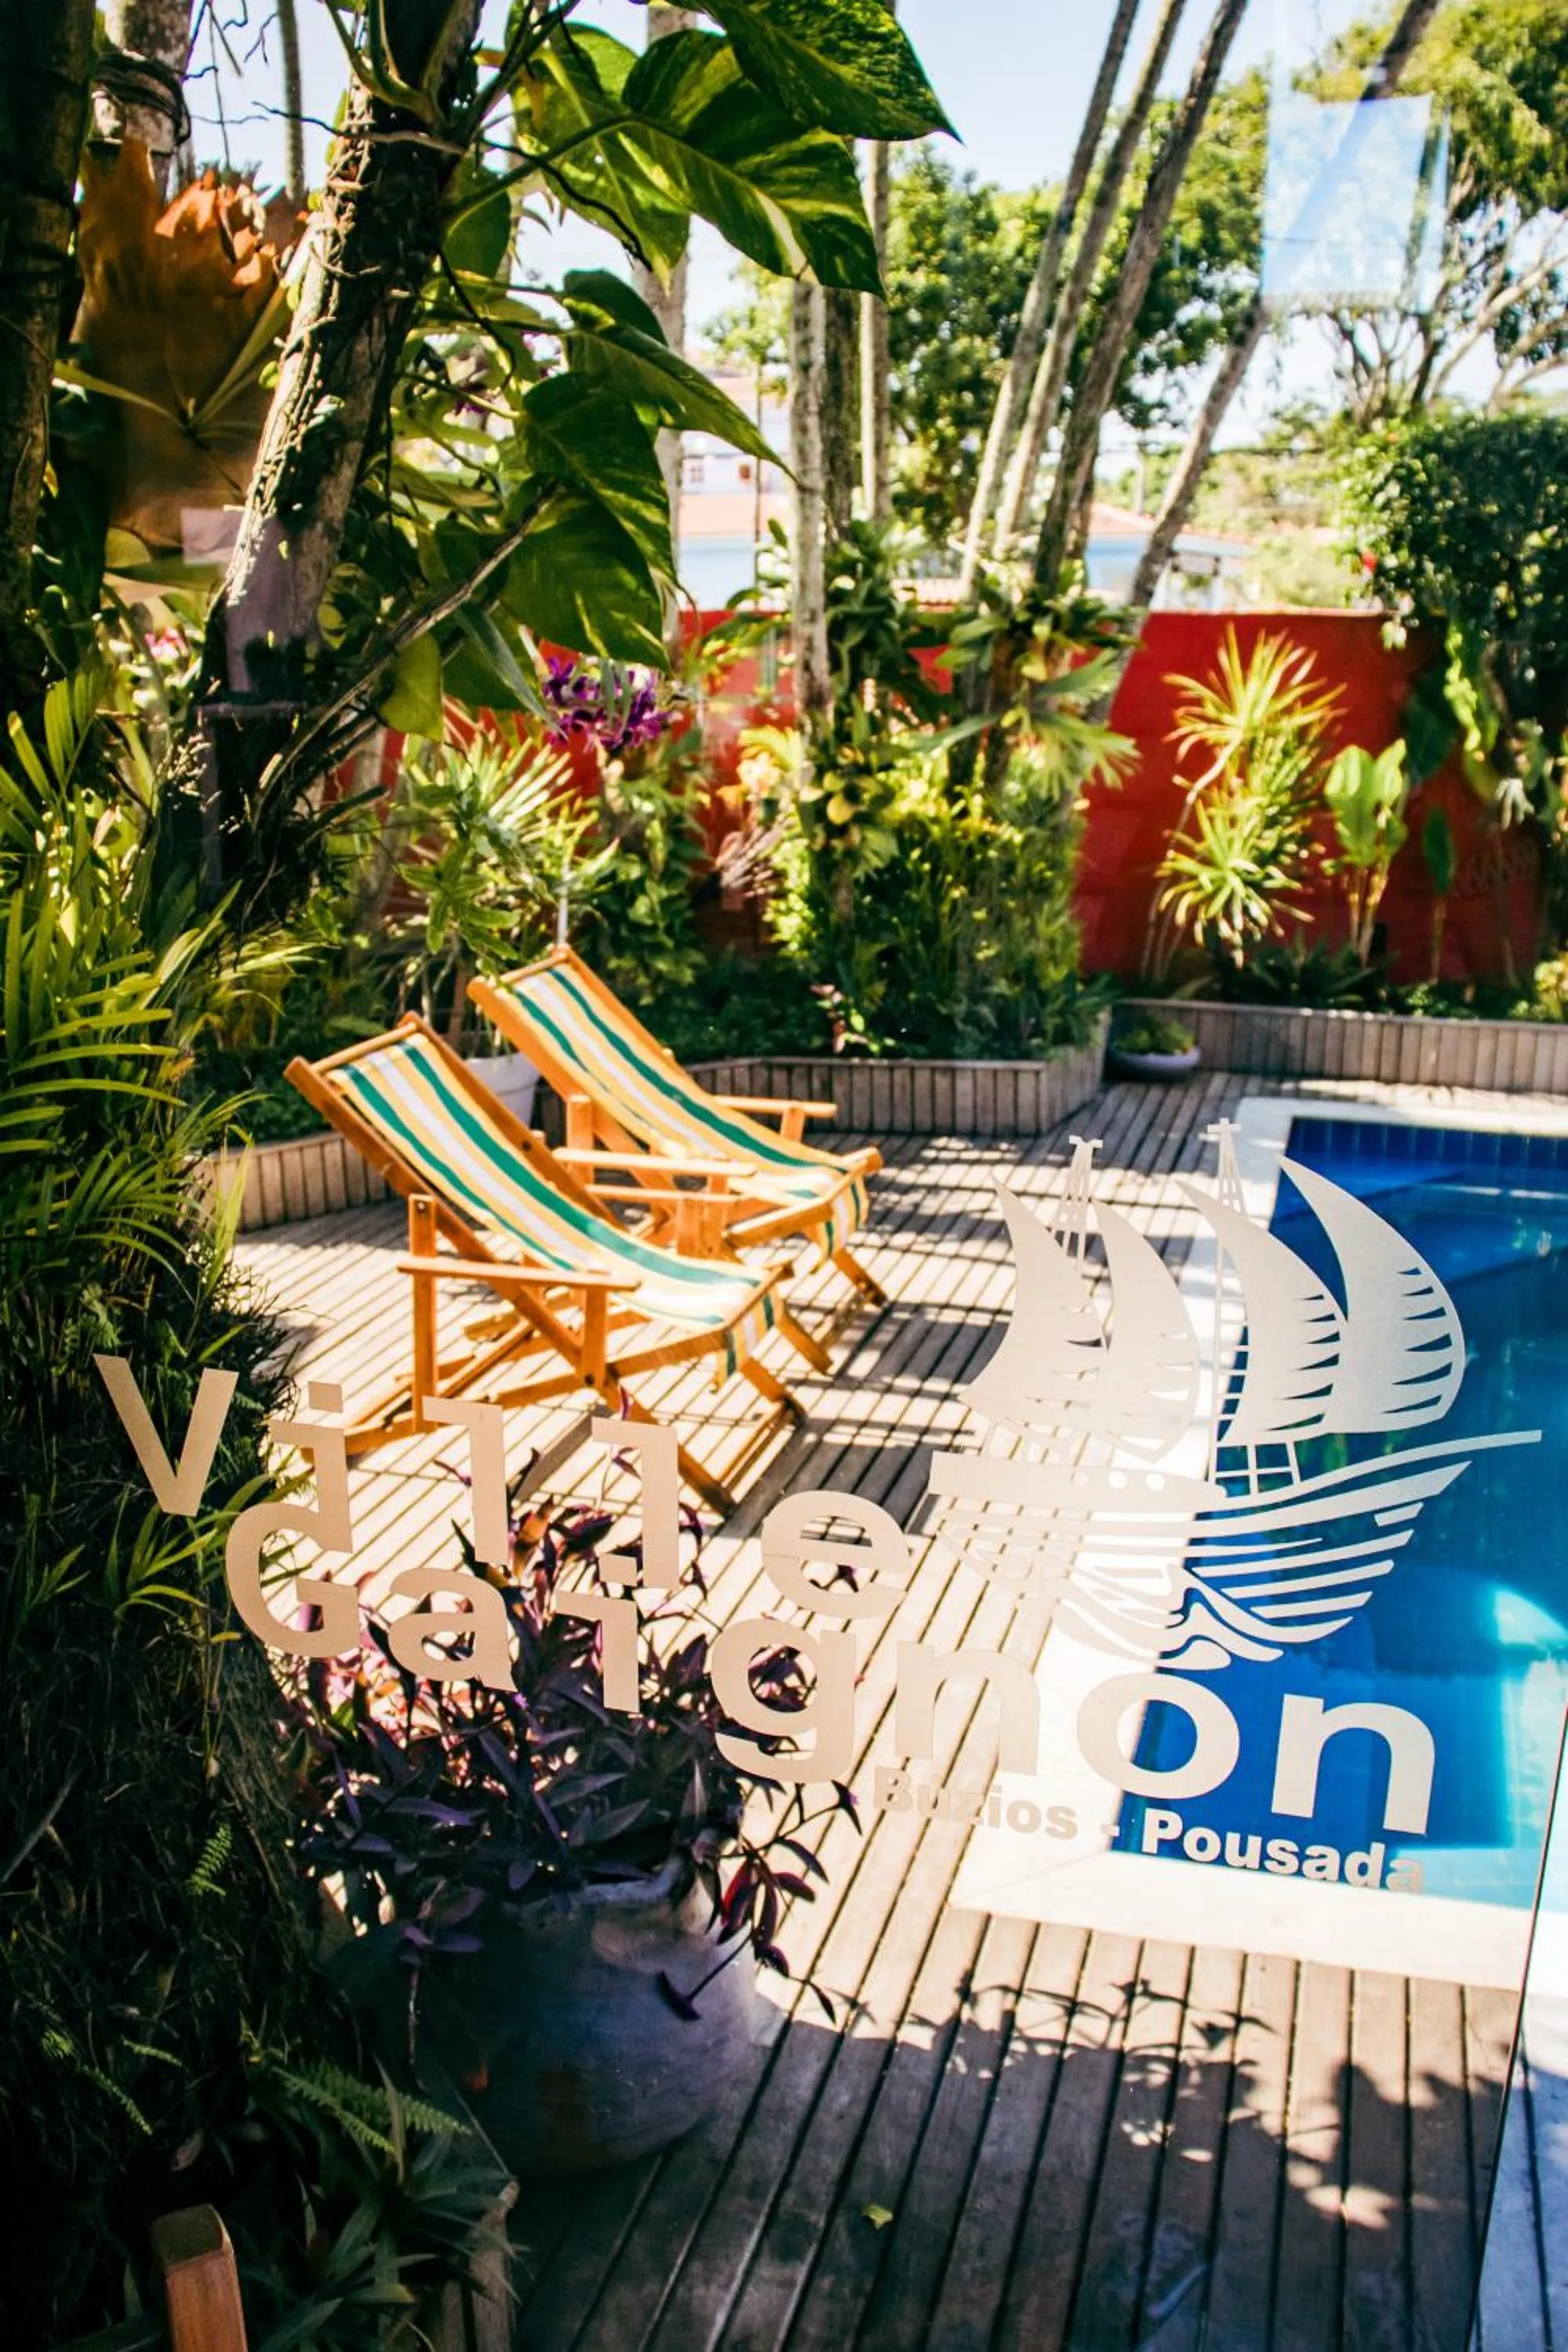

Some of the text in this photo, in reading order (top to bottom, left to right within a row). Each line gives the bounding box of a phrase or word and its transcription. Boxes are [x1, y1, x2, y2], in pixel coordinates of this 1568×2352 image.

[93, 1354, 912, 1619] Ville
[226, 1502, 1436, 1835] Gaignon
[1142, 1807, 1425, 1894] Pousada
